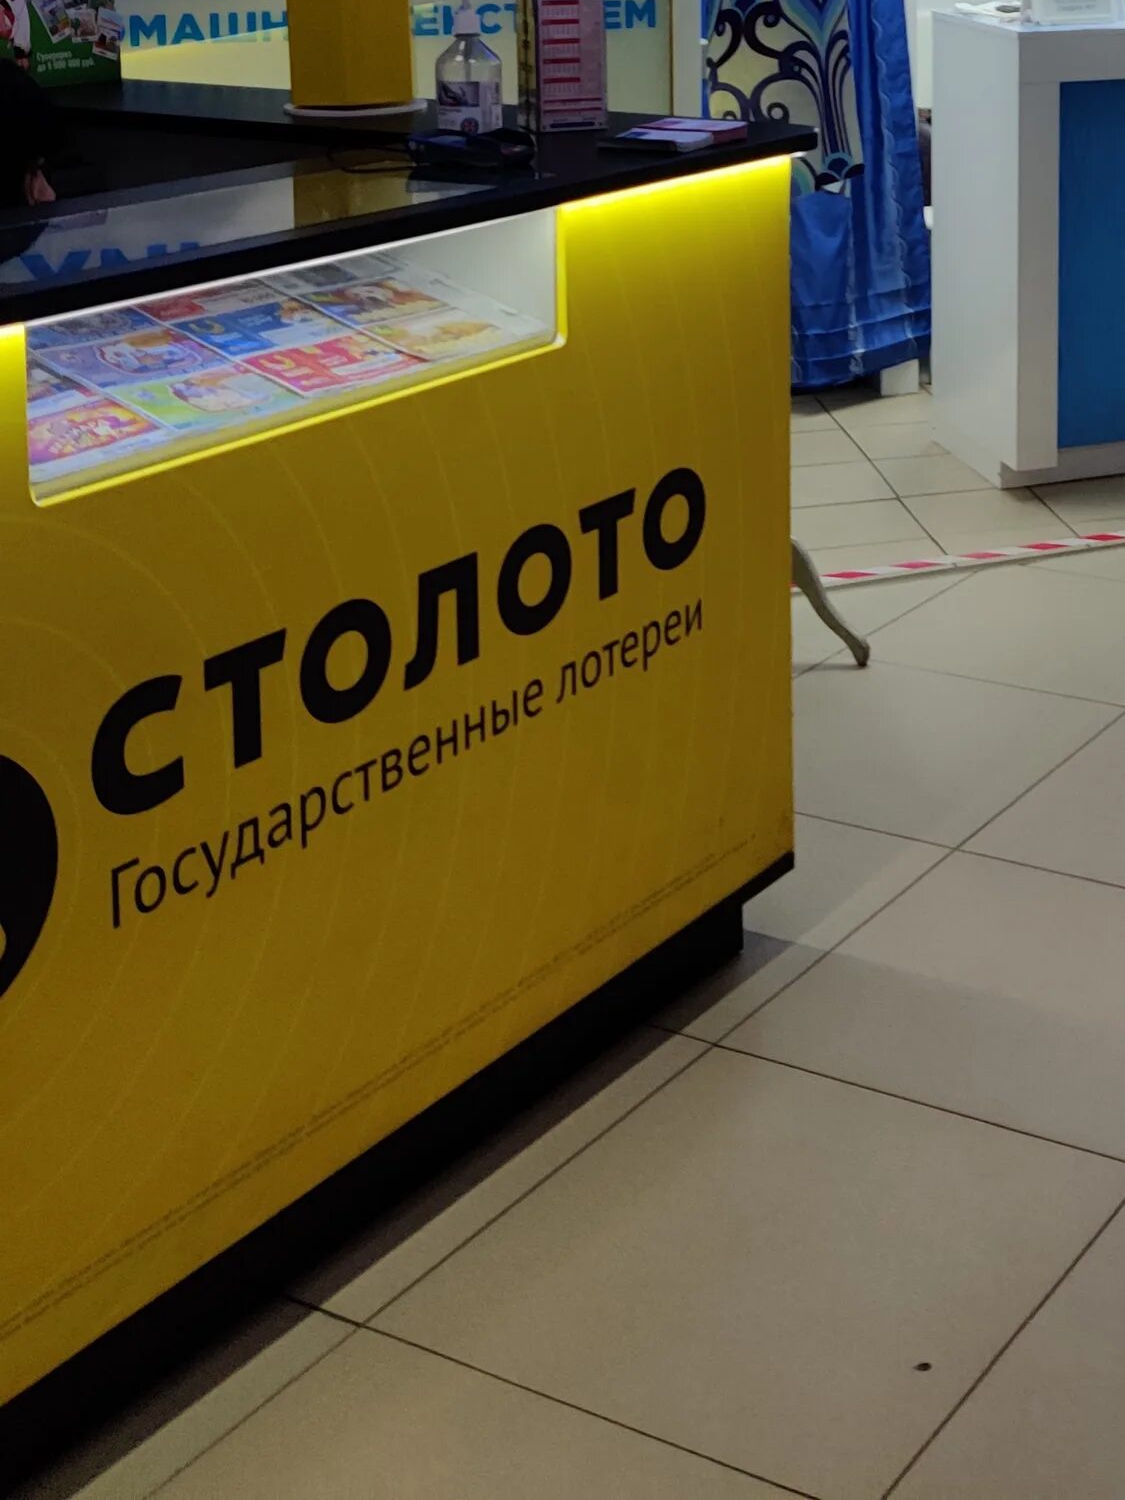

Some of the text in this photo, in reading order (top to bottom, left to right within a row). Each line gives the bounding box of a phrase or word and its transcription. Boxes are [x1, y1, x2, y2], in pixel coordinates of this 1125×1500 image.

[91, 467, 706, 816] СТОЛОТО
[110, 680, 543, 929] Государственные
[556, 599, 703, 705] лотереи
